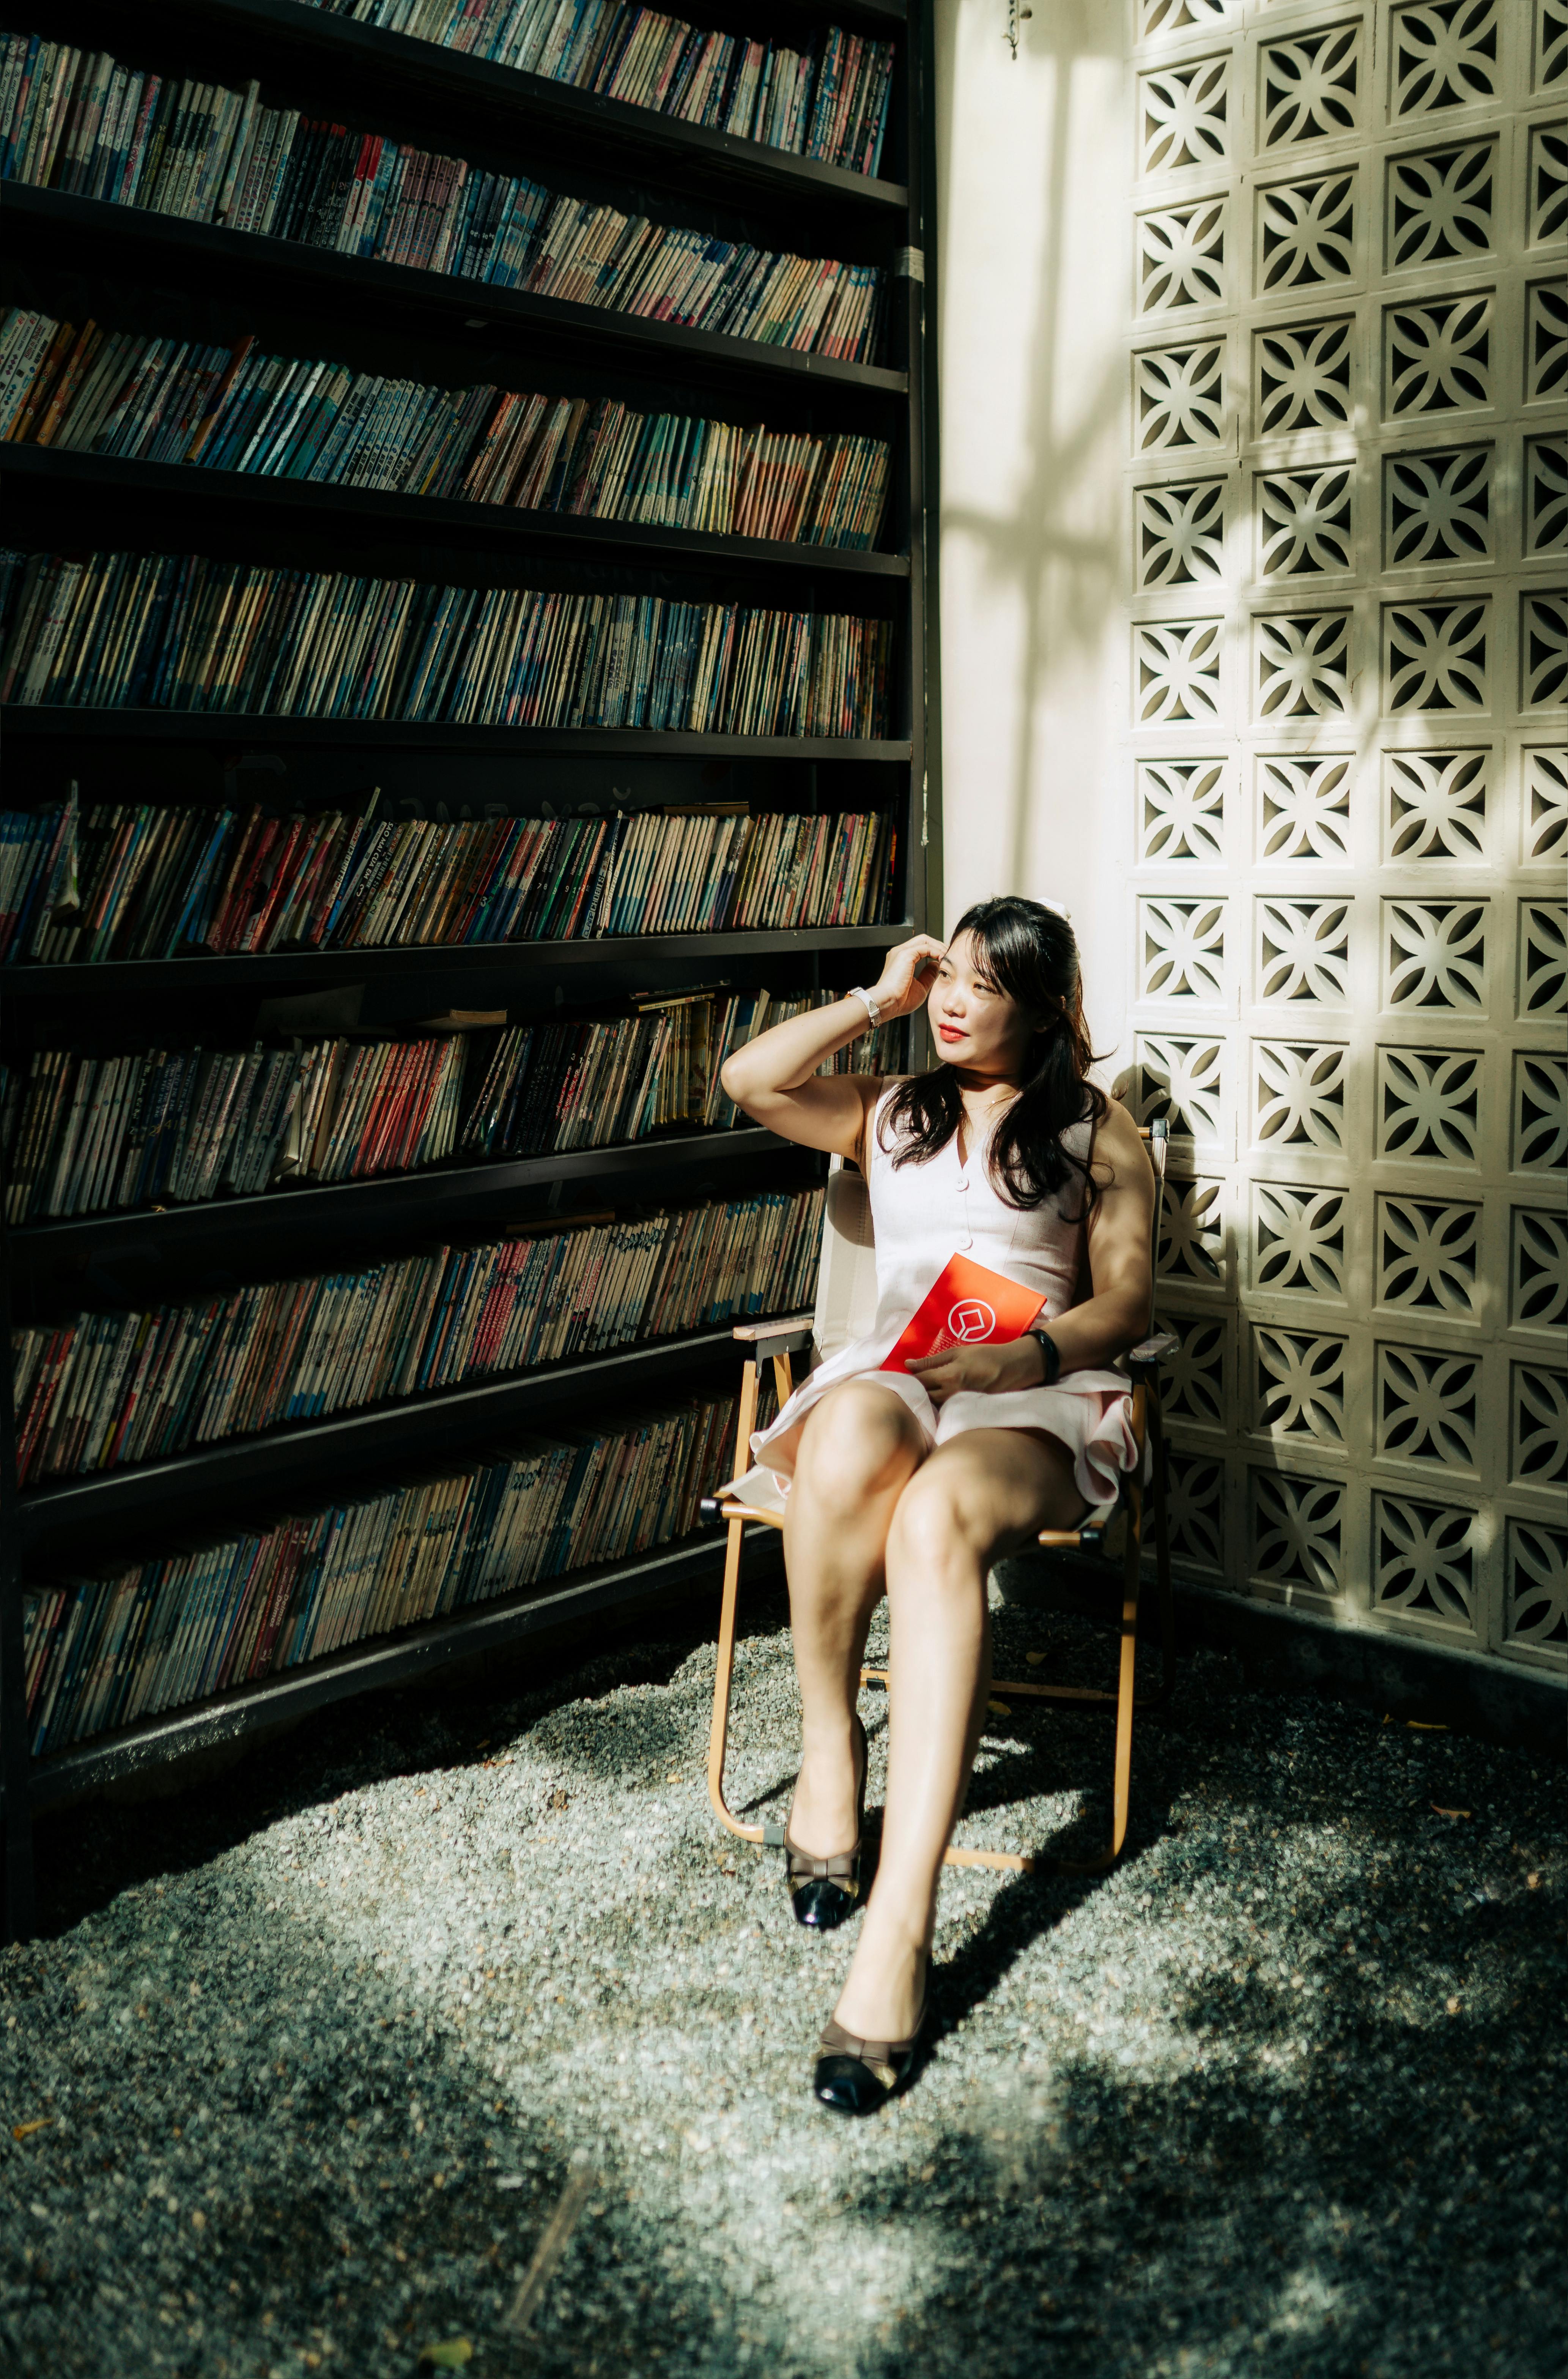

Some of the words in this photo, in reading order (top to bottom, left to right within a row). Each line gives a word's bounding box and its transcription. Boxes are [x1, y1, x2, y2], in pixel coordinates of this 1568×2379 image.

[155, 182, 164, 197] TRUNG
[166, 184, 175, 199] TRUNG
[176, 184, 185, 200] TRUNG
[187, 185, 195, 201] TRUNG
[23, 346, 33, 358] Kimi
[32, 323, 43, 341] Todoke
[382, 821, 394, 837] SAO
[375, 837, 387, 852] MAI
[582, 911, 595, 937] CLAMP
[590, 875, 604, 911] CHOBITS
[284, 1093, 297, 1117] ANGEL
[277, 1117, 289, 1138] SHOP
[268, 1594, 282, 1628] Deimos
[275, 1593, 289, 1627] Deimos
